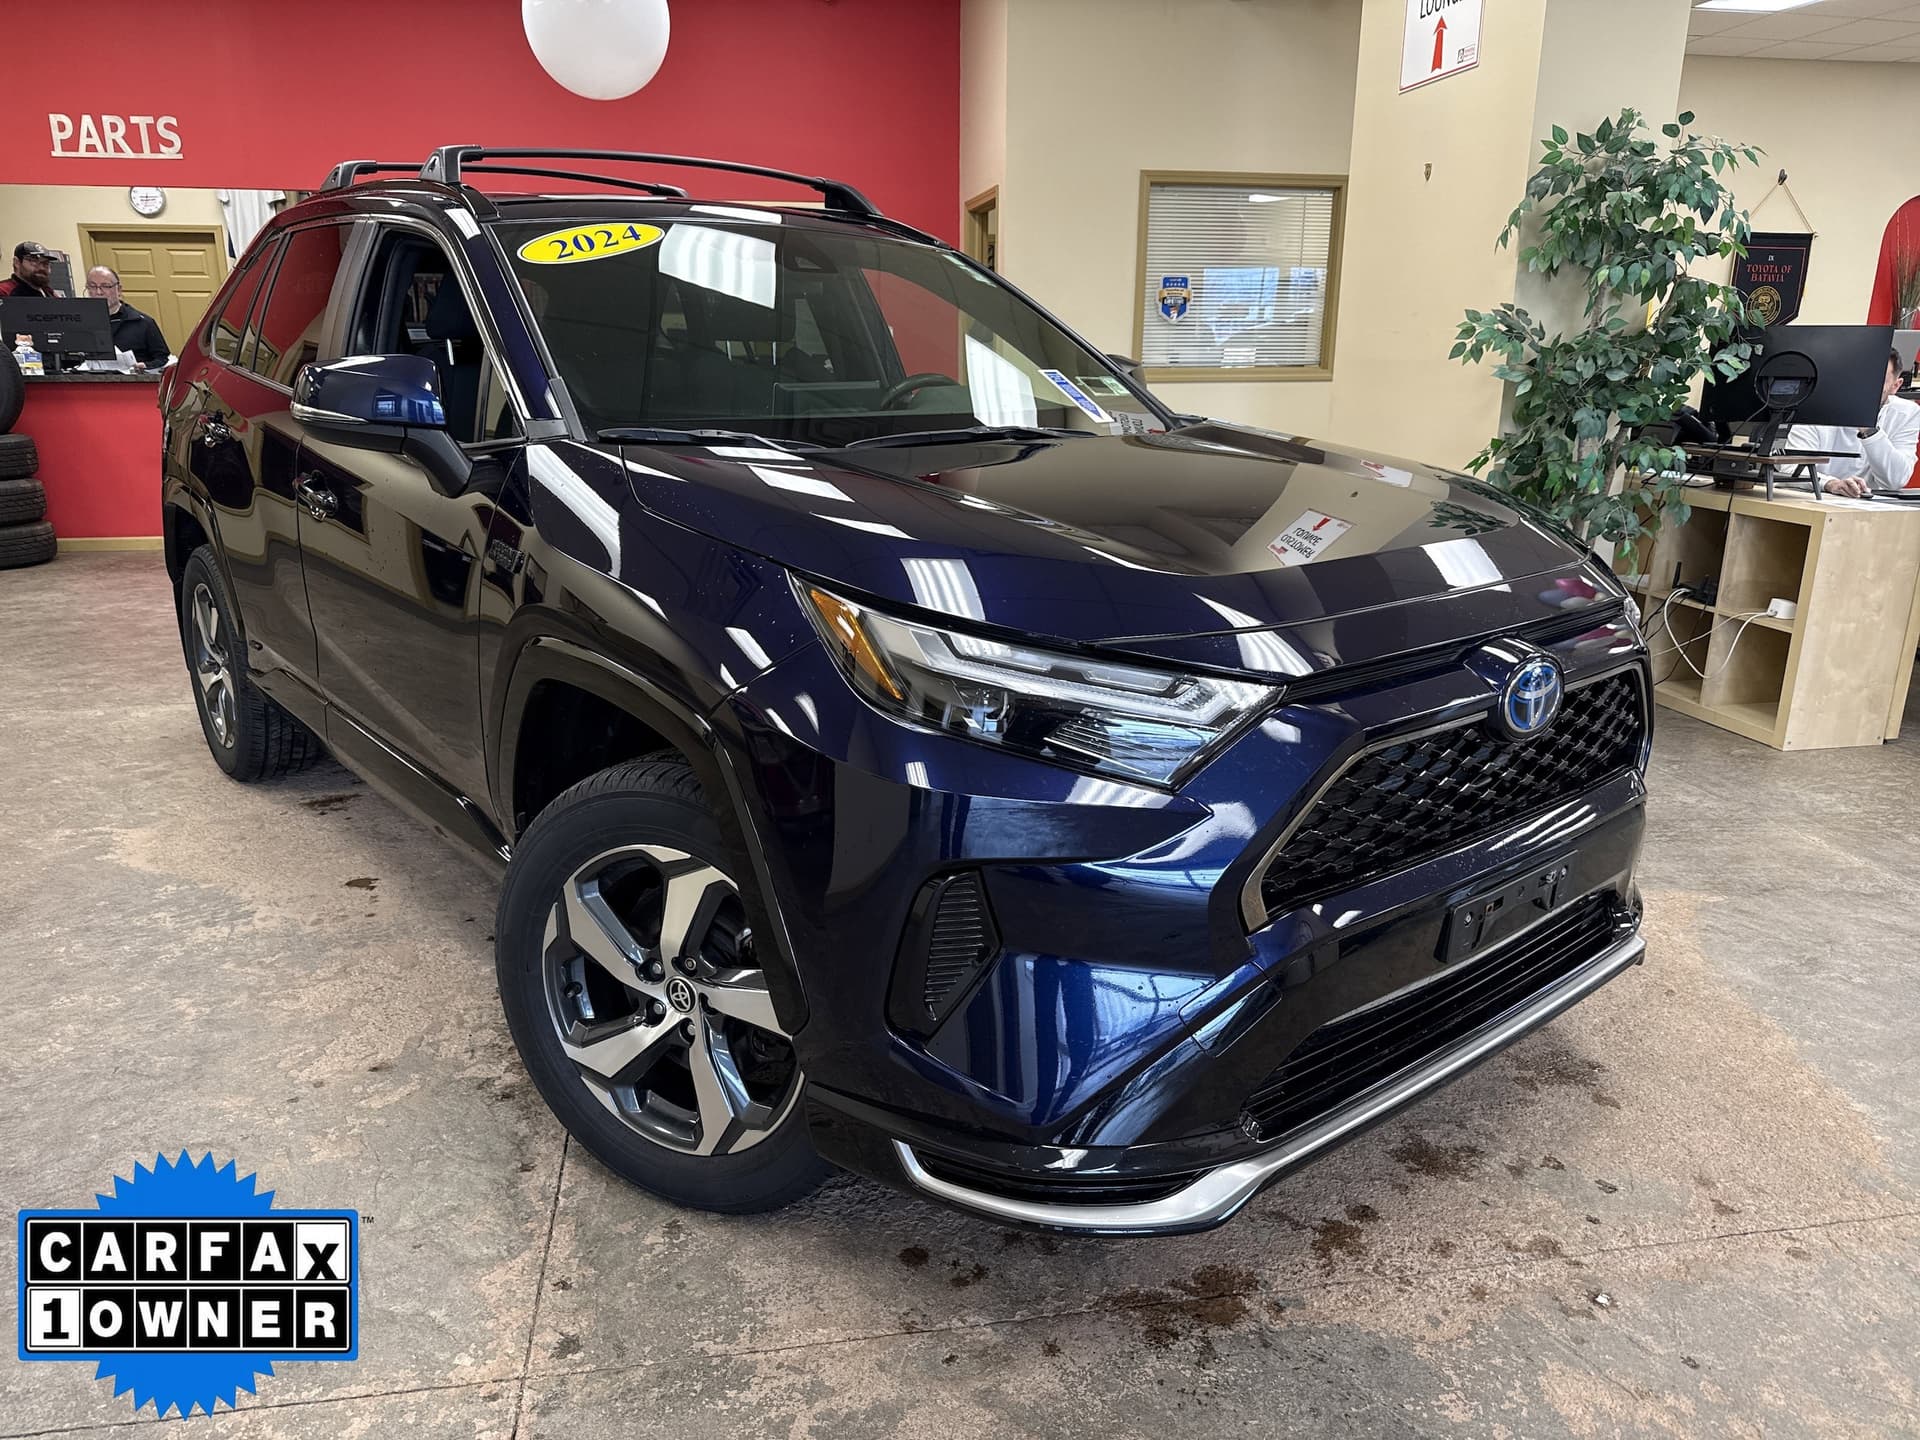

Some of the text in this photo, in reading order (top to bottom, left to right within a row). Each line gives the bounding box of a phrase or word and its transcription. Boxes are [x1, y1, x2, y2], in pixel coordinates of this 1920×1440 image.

[48, 113, 183, 158] PARTS
[549, 225, 641, 259] 2024
[1746, 264, 1792, 273] TOYOTA OF
[1751, 273, 1784, 282] BATAVIA
